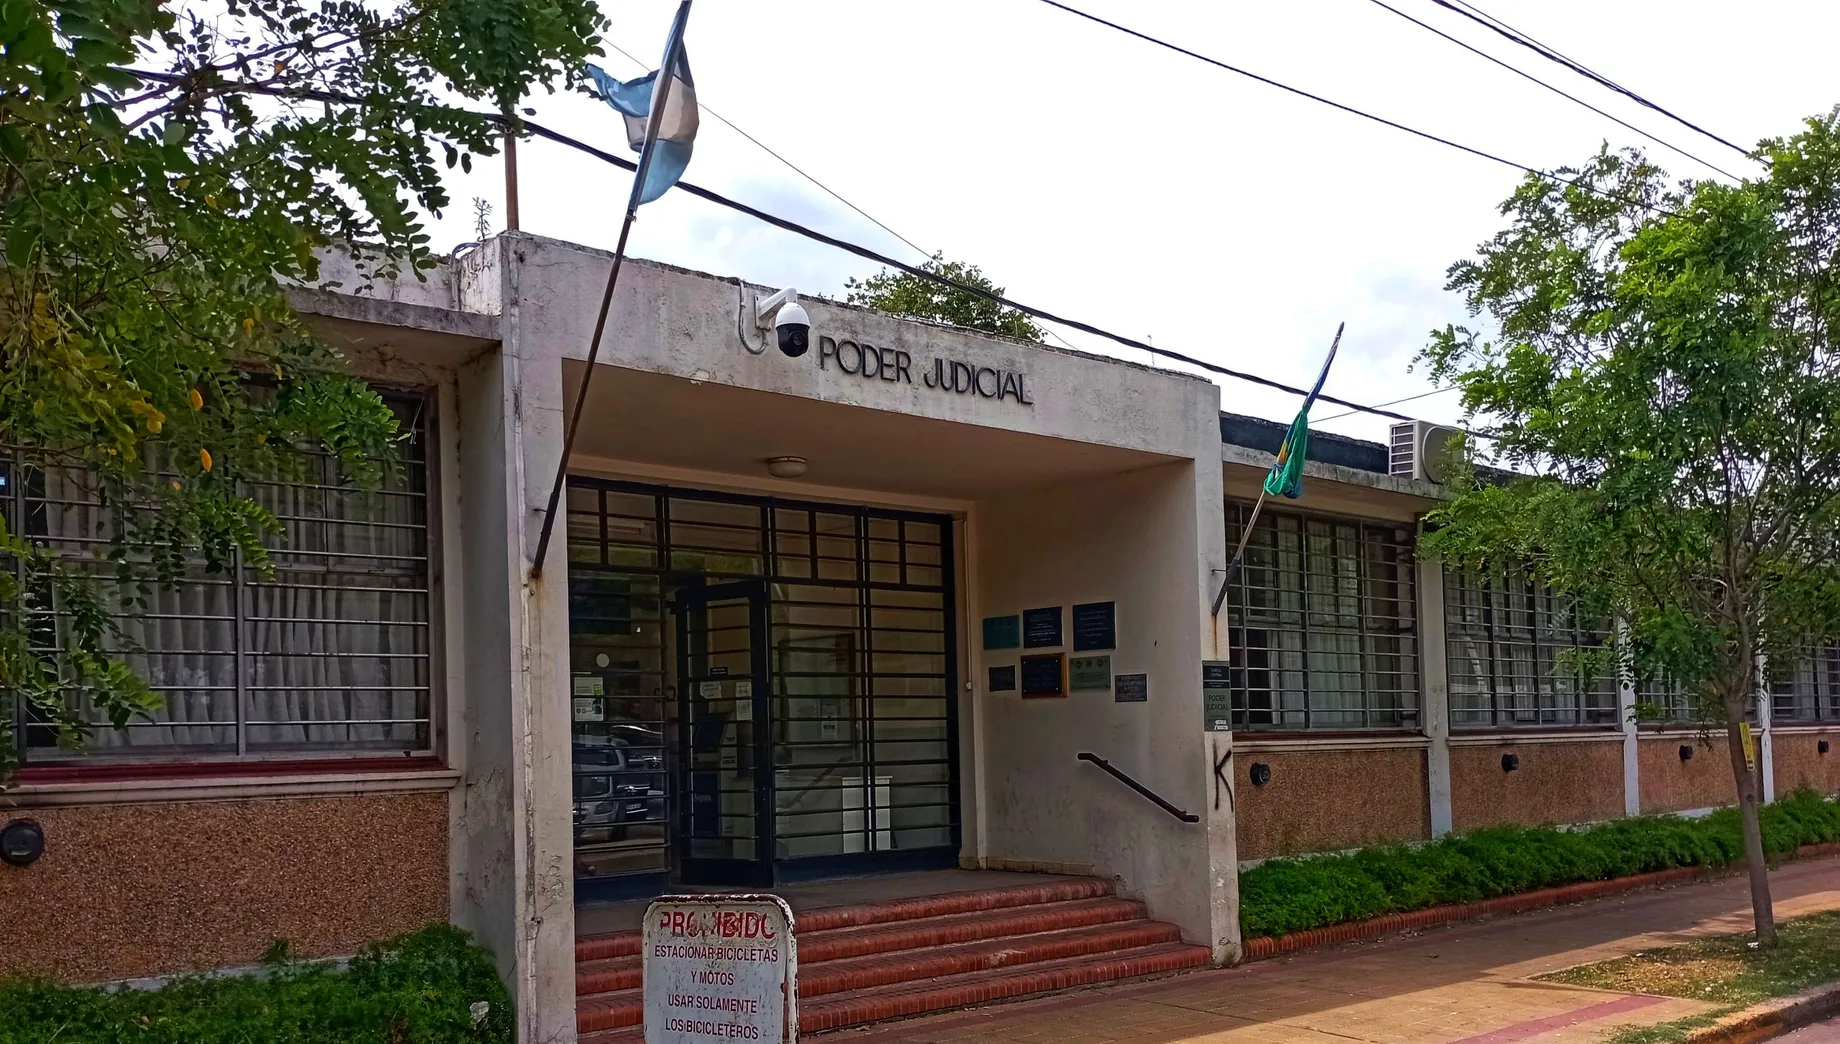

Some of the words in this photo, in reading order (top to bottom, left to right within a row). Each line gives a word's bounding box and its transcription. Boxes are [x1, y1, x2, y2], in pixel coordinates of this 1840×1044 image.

[819, 336, 912, 384] PODER
[924, 358, 1034, 405] JUDICIAL
[1206, 703, 1229, 712] JUDICIAL
[1208, 694, 1226, 702] PODER
[1213, 739, 1234, 813] K
[655, 945, 715, 960] ESTACIONAR
[717, 947, 779, 963] BICICLETAS
[691, 971, 698, 984] Y
[699, 971, 735, 986] MOTOS
[668, 994, 694, 1007] USAR
[696, 995, 758, 1014] SOLAMENTE
[665, 1018, 685, 1031] LOS
[686, 1020, 759, 1040] BICICLETEROS
